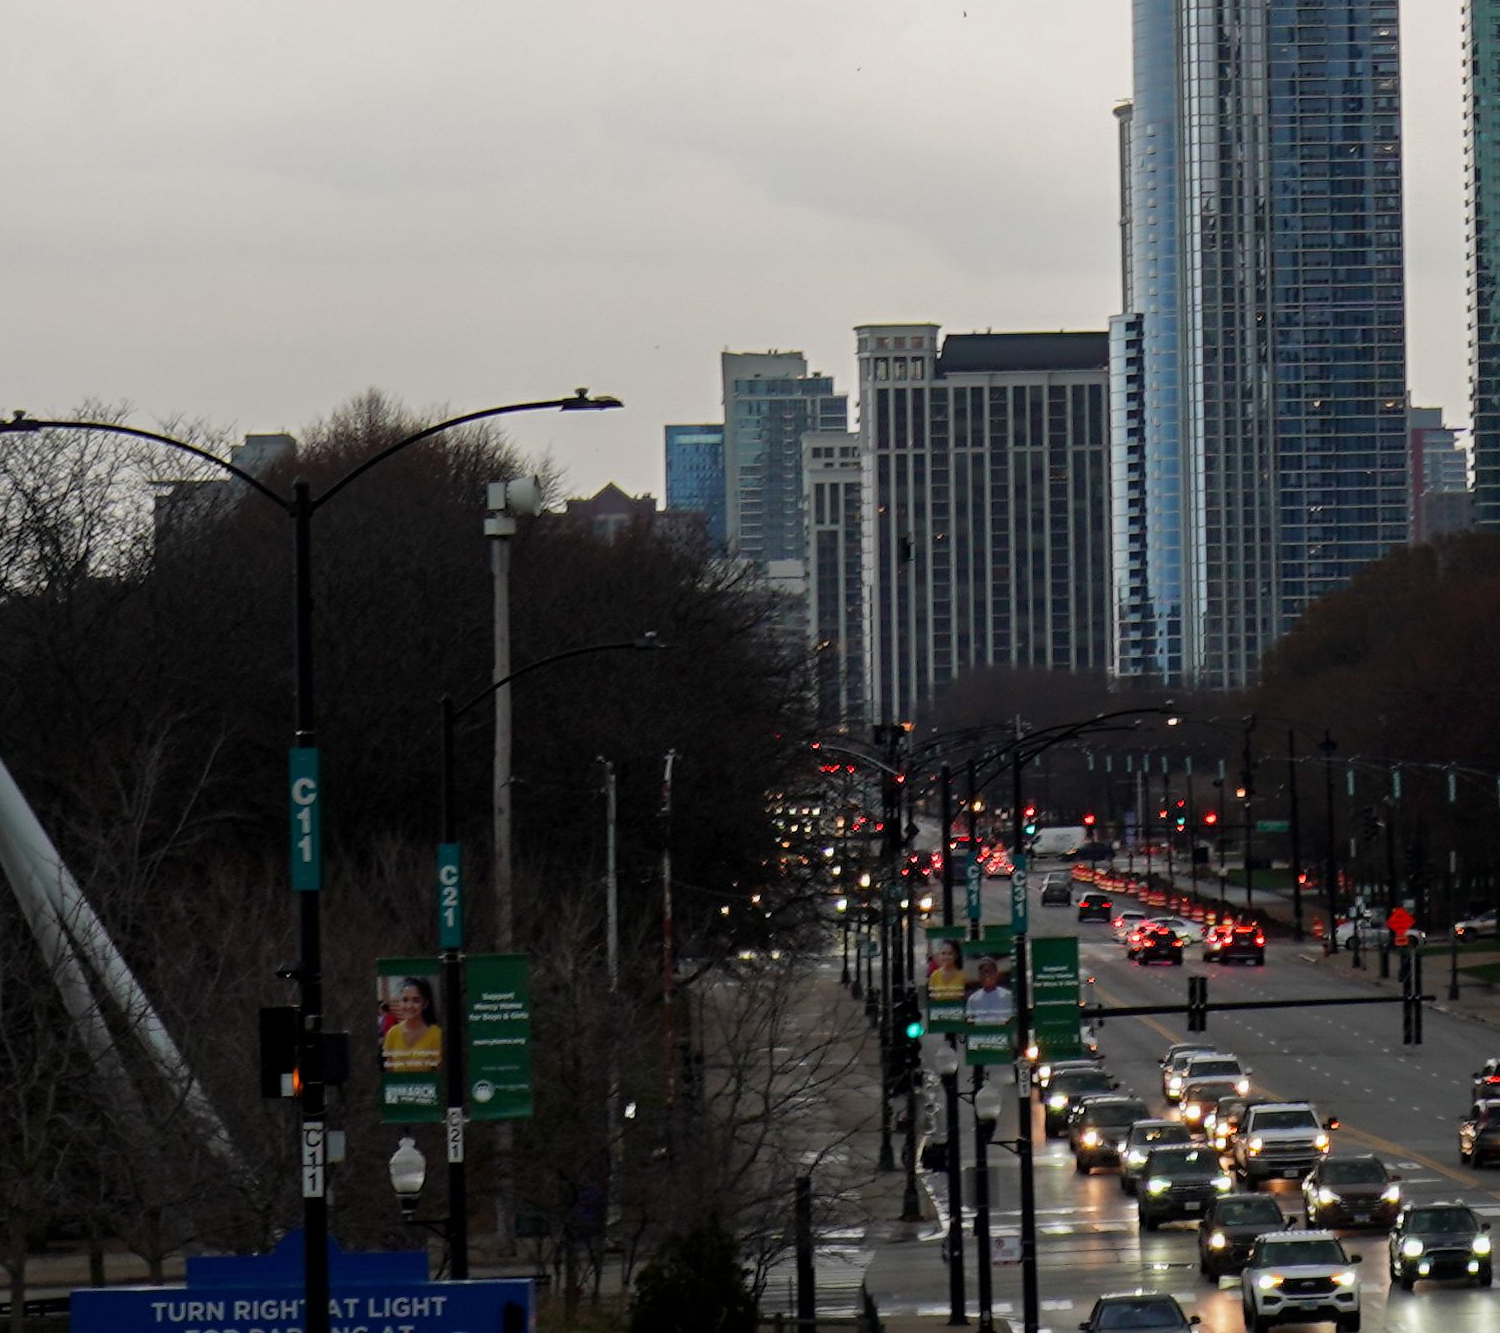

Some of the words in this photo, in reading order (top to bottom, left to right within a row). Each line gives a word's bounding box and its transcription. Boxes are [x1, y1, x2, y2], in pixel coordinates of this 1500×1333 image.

[291, 777, 318, 863] C11
[439, 864, 460, 928] C21
[1012, 871, 1027, 917] C31
[304, 1128, 321, 1192] C11
[150, 1299, 225, 1323] TURN
[233, 1298, 307, 1322] RIGH
[326, 1298, 361, 1319] AT
[367, 1295, 449, 1318] LIGHT
